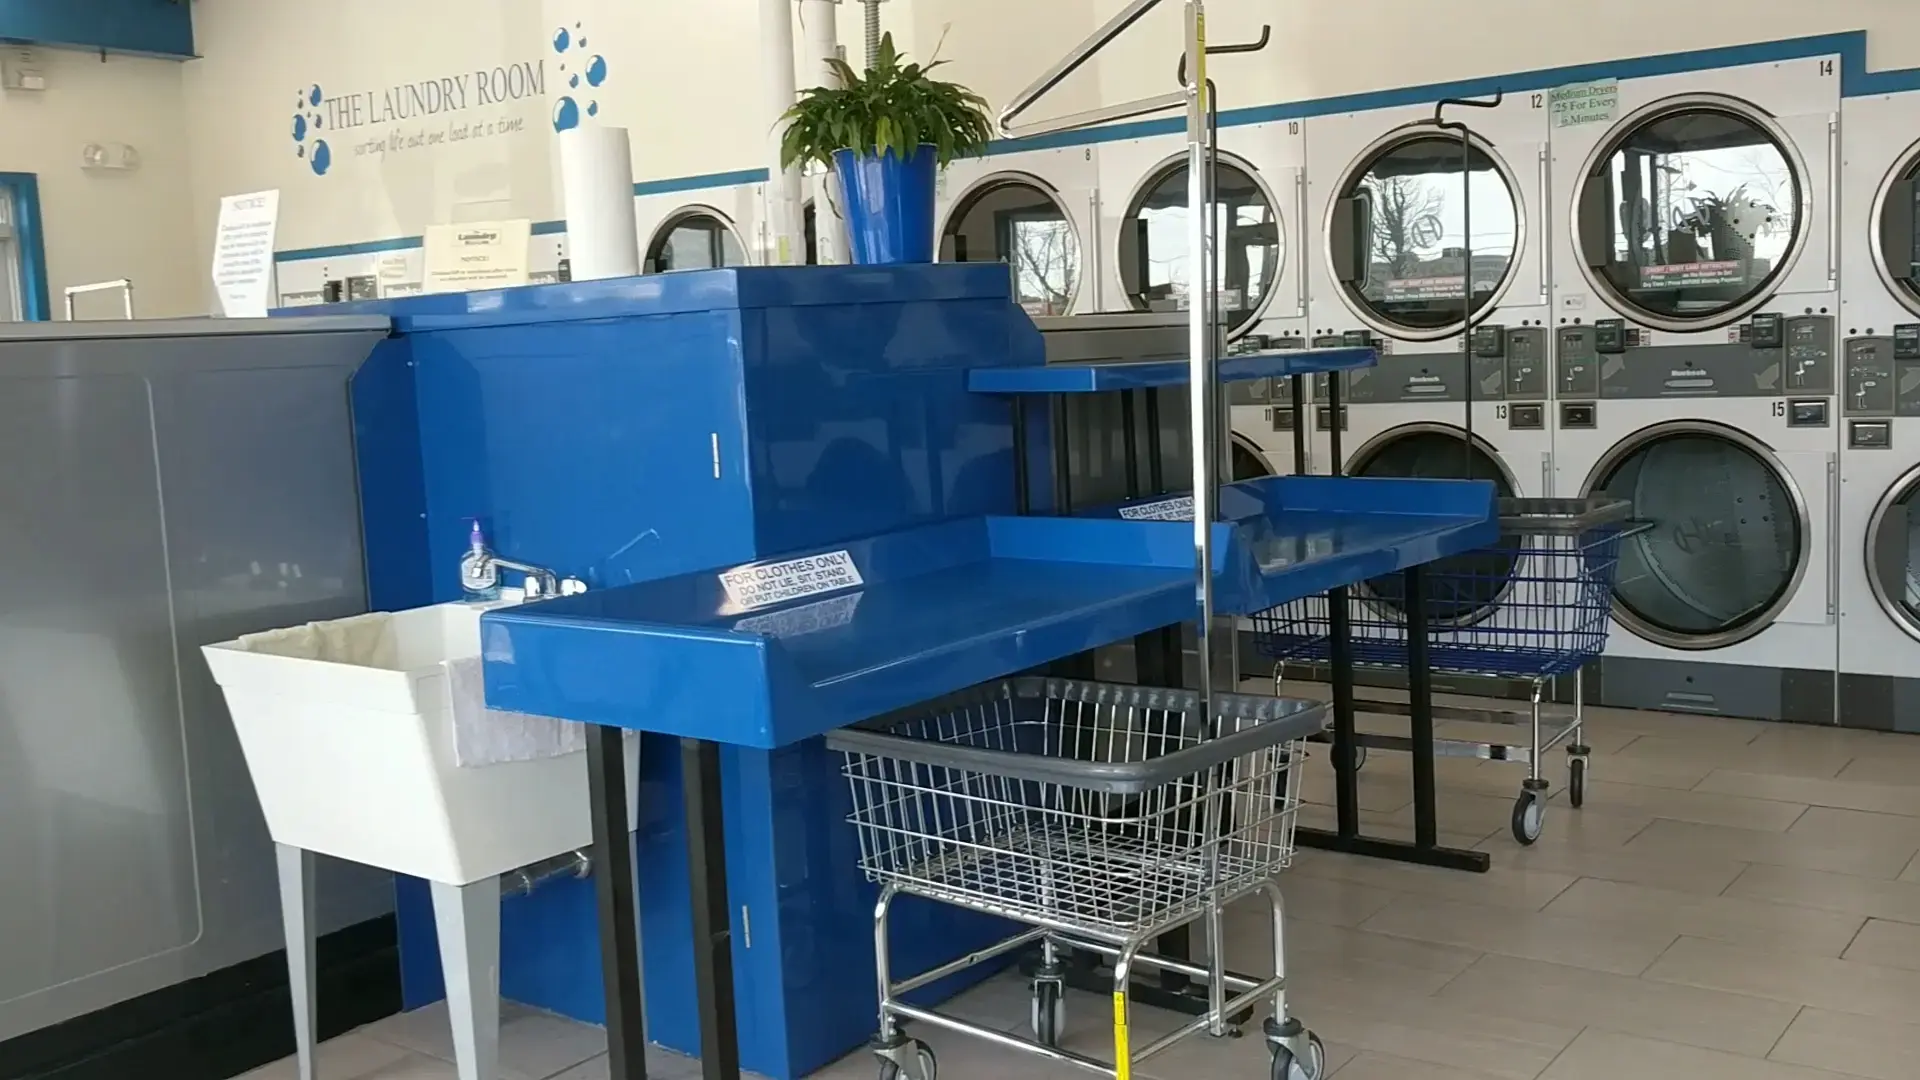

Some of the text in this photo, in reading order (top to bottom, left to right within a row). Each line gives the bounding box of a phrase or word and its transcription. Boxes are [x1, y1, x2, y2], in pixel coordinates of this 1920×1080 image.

[1820, 60, 1832, 76] 14
[324, 59, 545, 130] THE LAUNDRY ROOM
[1531, 94, 1542, 108] 12
[1570, 101, 1586, 111] For
[1589, 98, 1615, 108] Every
[1288, 122, 1299, 135] 10
[353, 116, 524, 163] sorting life out one load at a time
[1084, 148, 1091, 161] 8
[1264, 408, 1272, 421] 11
[1496, 405, 1507, 419] 13
[1772, 402, 1785, 417] 15
[1122, 508, 1140, 517] FOR
[1140, 502, 1174, 515] CLOTHES
[1174, 499, 1193, 509] ONLY
[724, 552, 849, 588] FOR CLOTHES ONLY
[739, 585, 755, 596] DO
[757, 580, 776, 592] NOT
[815, 567, 846, 580] STAND
[740, 576, 854, 606] OR PUT CHILDREN ON TABLE
